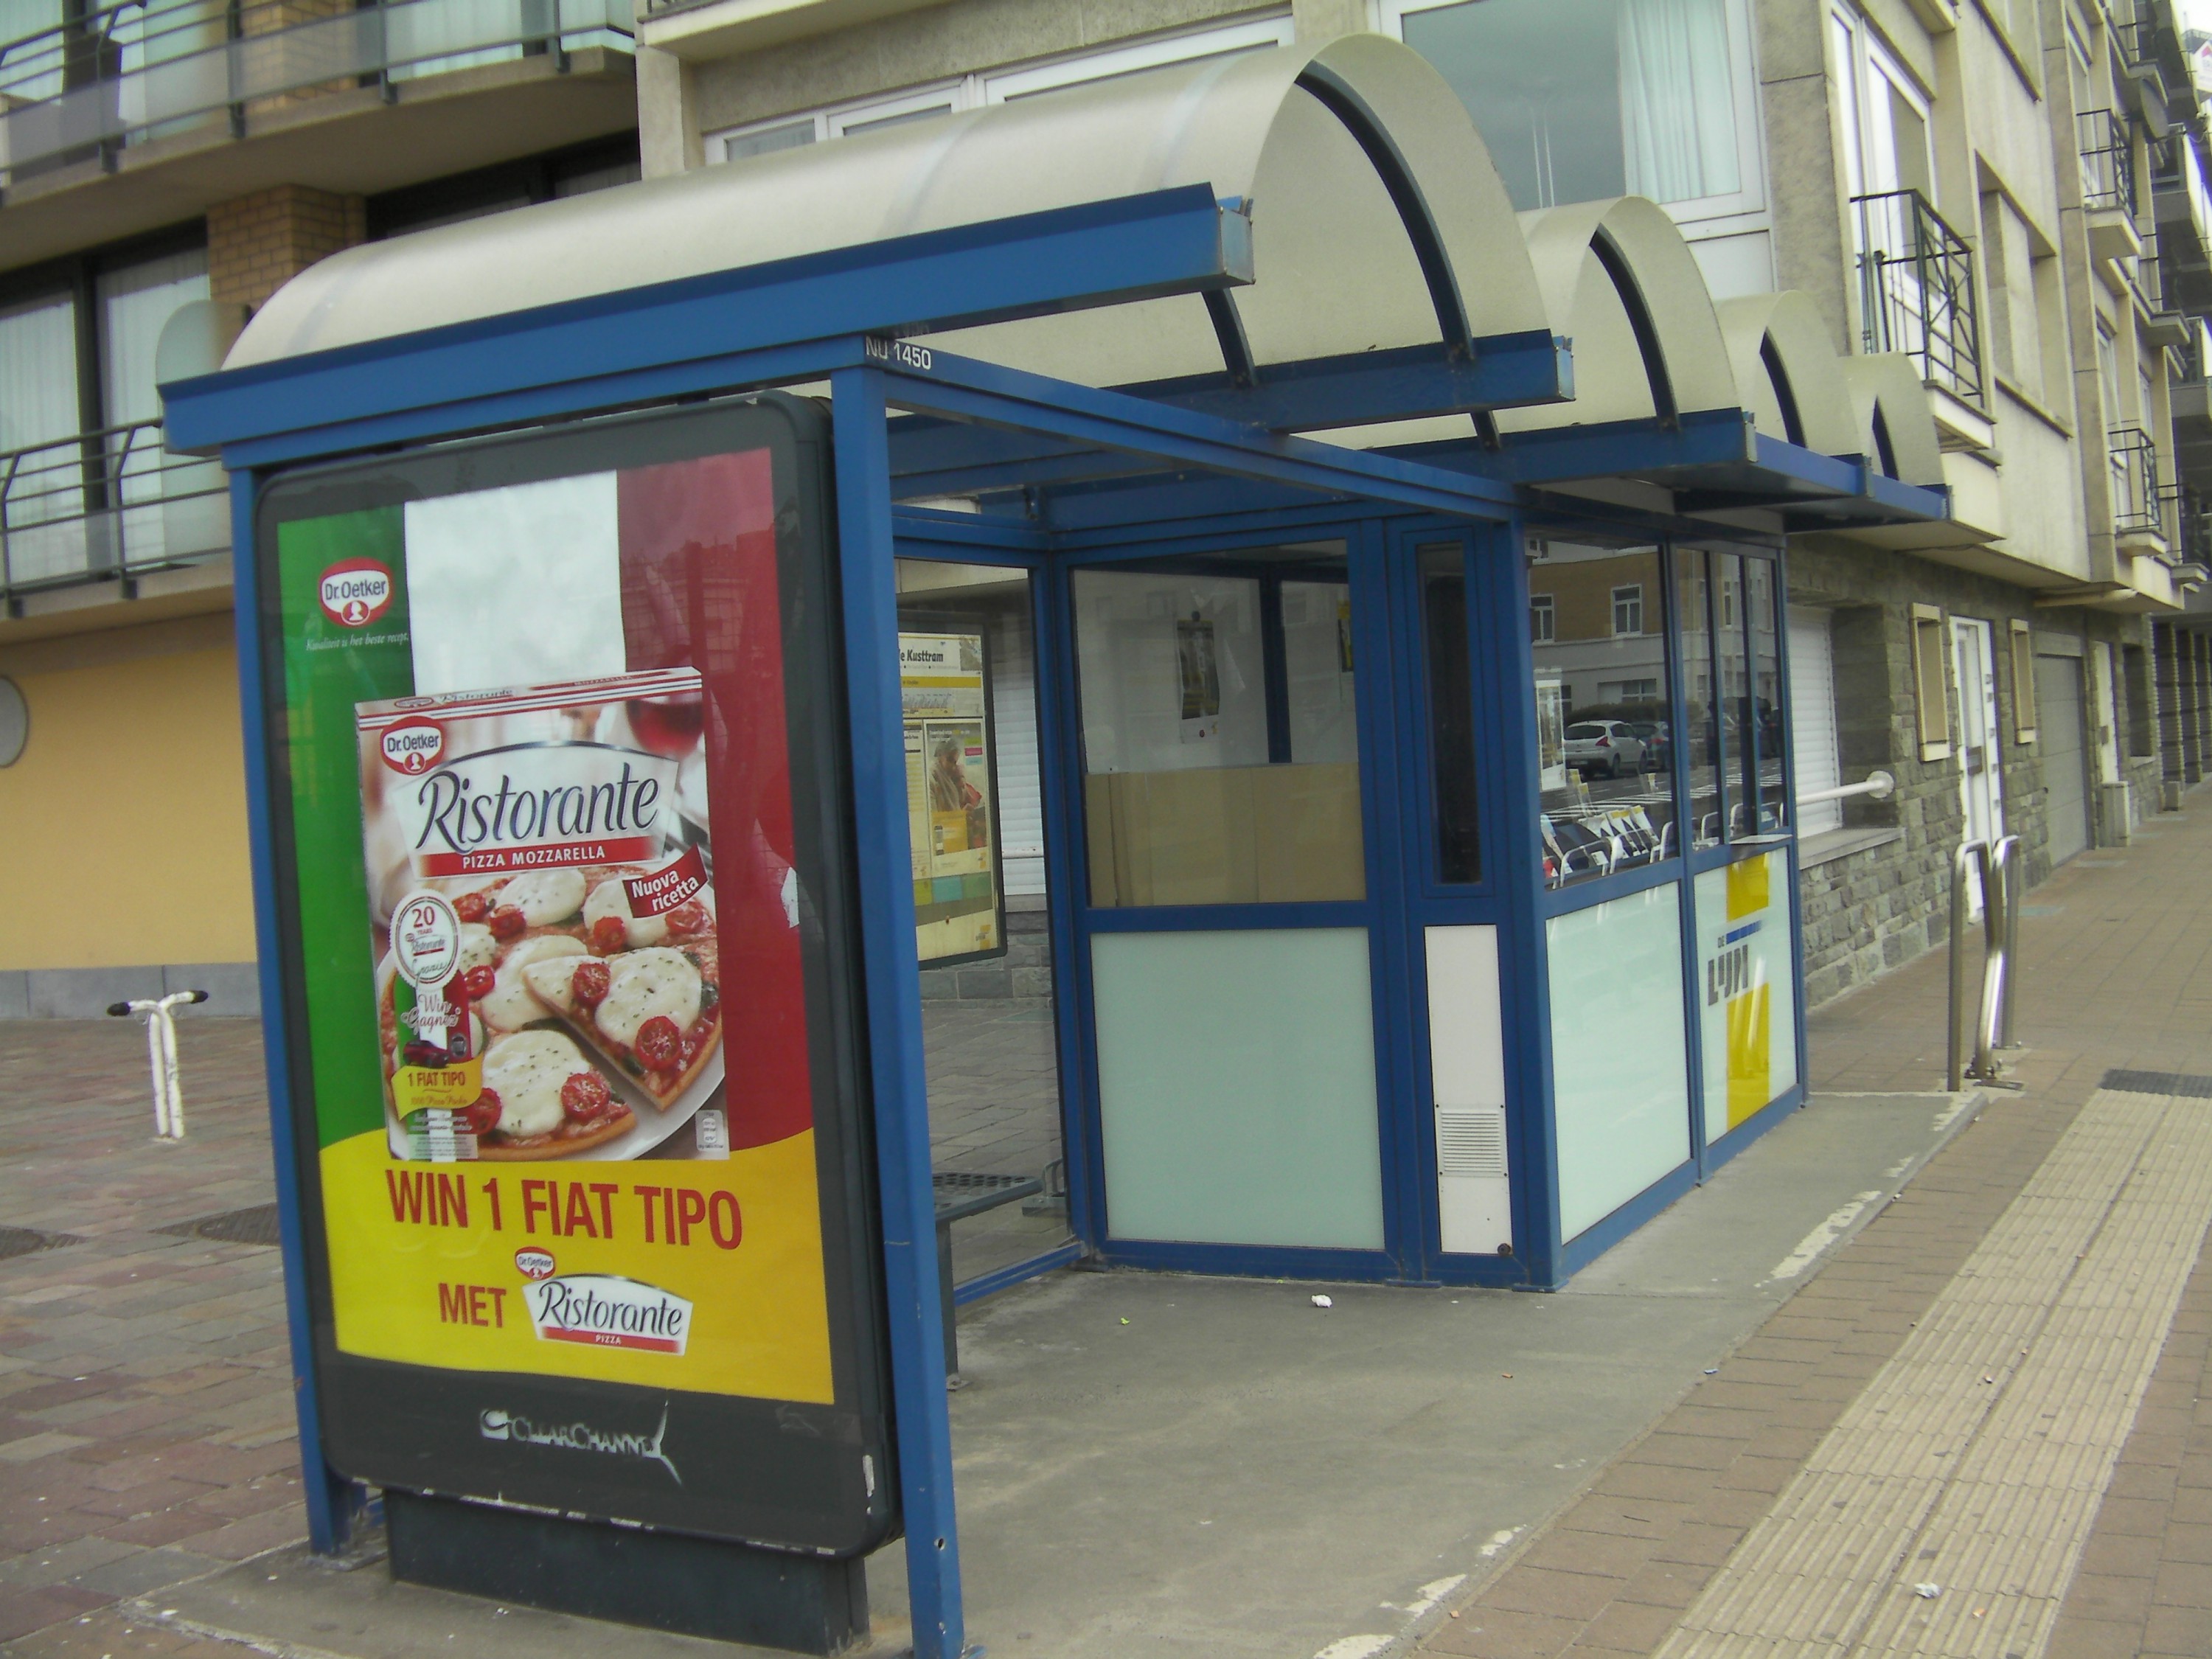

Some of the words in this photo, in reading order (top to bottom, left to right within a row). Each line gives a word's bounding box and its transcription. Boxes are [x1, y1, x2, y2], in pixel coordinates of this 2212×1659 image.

[894, 342, 932, 369] 1450
[341, 579, 386, 599] Oetker
[349, 634, 363, 646] het
[365, 633, 385, 645] beste
[907, 649, 944, 662] Kusttram
[403, 733, 439, 749] Oetker
[416, 762, 659, 854] Ristorante
[462, 853, 505, 869] PIZZA
[512, 845, 605, 866] MOZZARELLA
[631, 870, 680, 898] Nuova
[652, 877, 699, 911] ricetta
[412, 905, 435, 928] 20
[1708, 944, 1748, 1006] LIJN
[418, 994, 451, 1014] Win
[407, 1074, 414, 1087] 1
[417, 1072, 438, 1087] FIAT
[441, 1071, 466, 1086] TIPO
[385, 1169, 468, 1228] WIN
[481, 1178, 502, 1231] 1
[521, 1179, 619, 1239] FIAT
[633, 1184, 743, 1251] TIPO
[437, 1282, 507, 1329] MET
[538, 1281, 683, 1337] Ristorante
[595, 1334, 622, 1346] PIZZA
